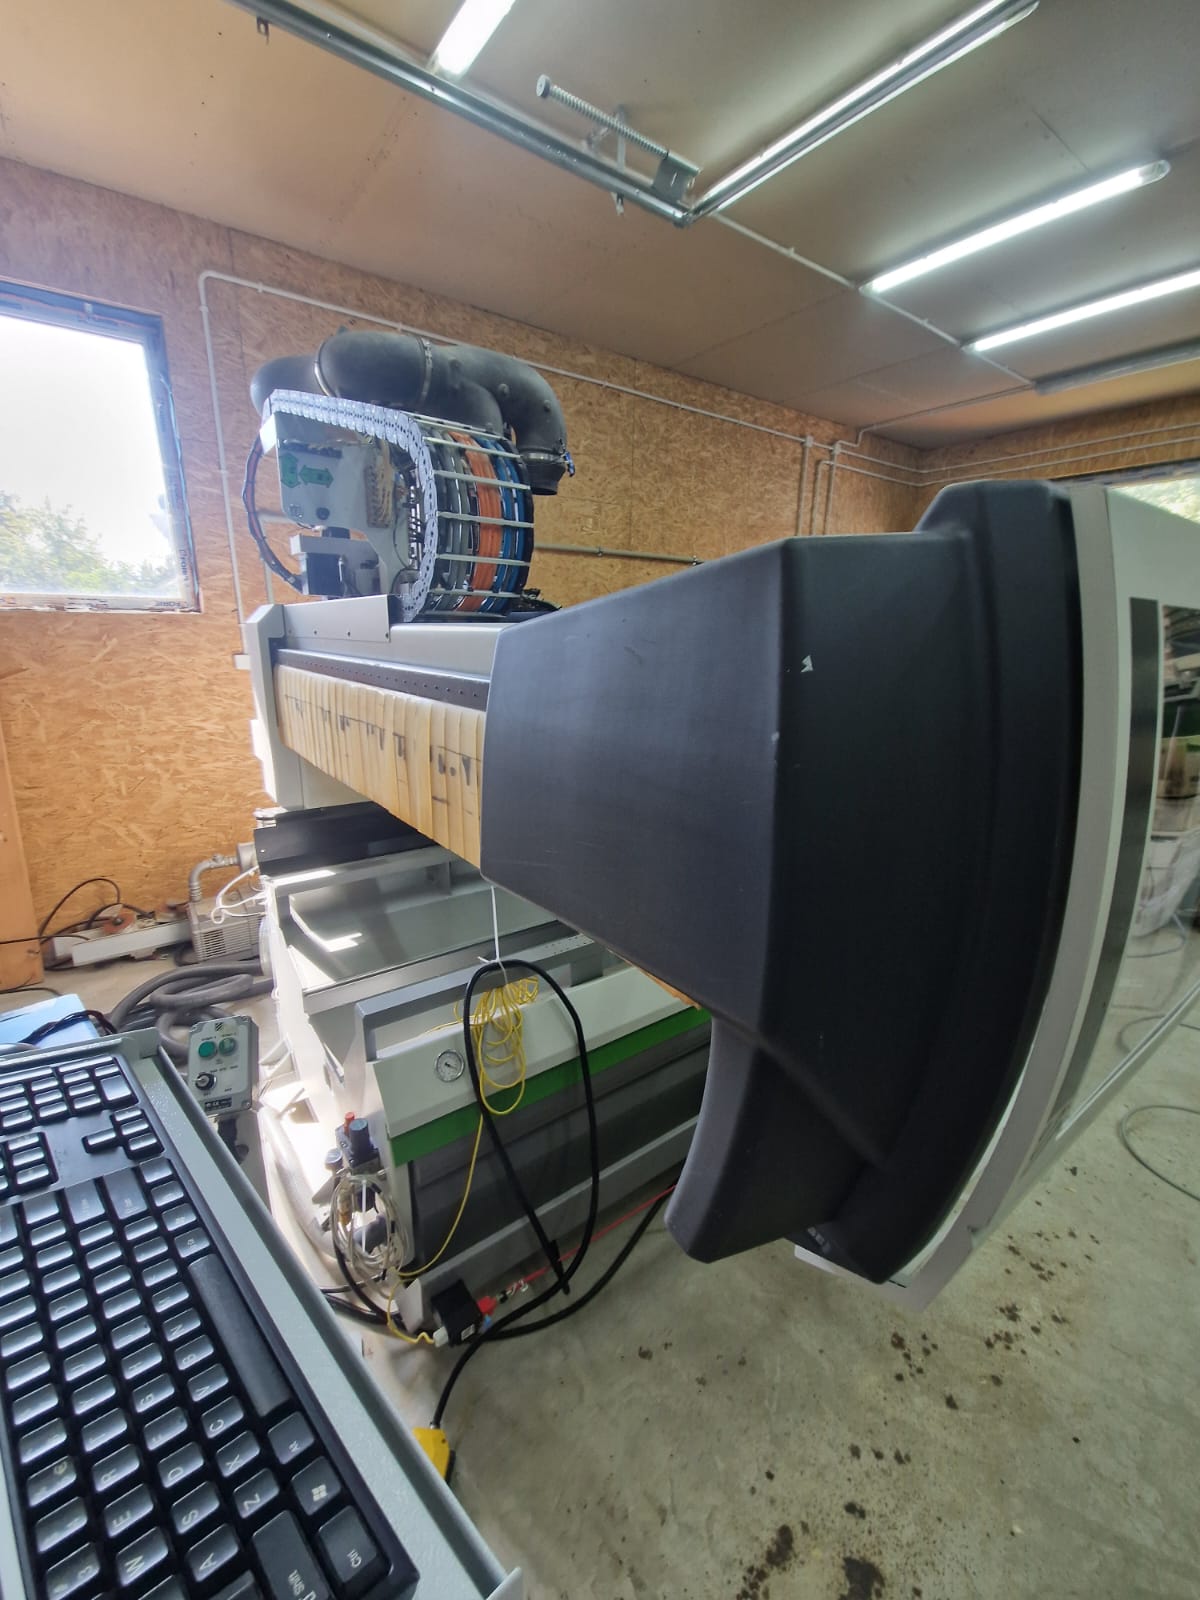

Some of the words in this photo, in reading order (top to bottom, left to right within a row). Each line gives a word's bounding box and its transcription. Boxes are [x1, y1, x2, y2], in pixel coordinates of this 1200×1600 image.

[170, 1324, 184, 1337] N
[182, 1353, 196, 1365] B
[195, 1385, 210, 1397] V
[139, 1393, 154, 1406] G
[209, 1419, 224, 1433] C
[225, 1454, 241, 1470] X
[100, 1468, 118, 1482] R
[167, 1466, 184, 1481] D
[243, 1493, 261, 1511] Z
[112, 1510, 131, 1527] E
[181, 1509, 199, 1525] S
[124, 1555, 145, 1577] W
[199, 1552, 217, 1572] A
[346, 1549, 362, 1568] Ctrl
[77, 1565, 94, 1579] 3
[288, 1569, 305, 1595] Shift
